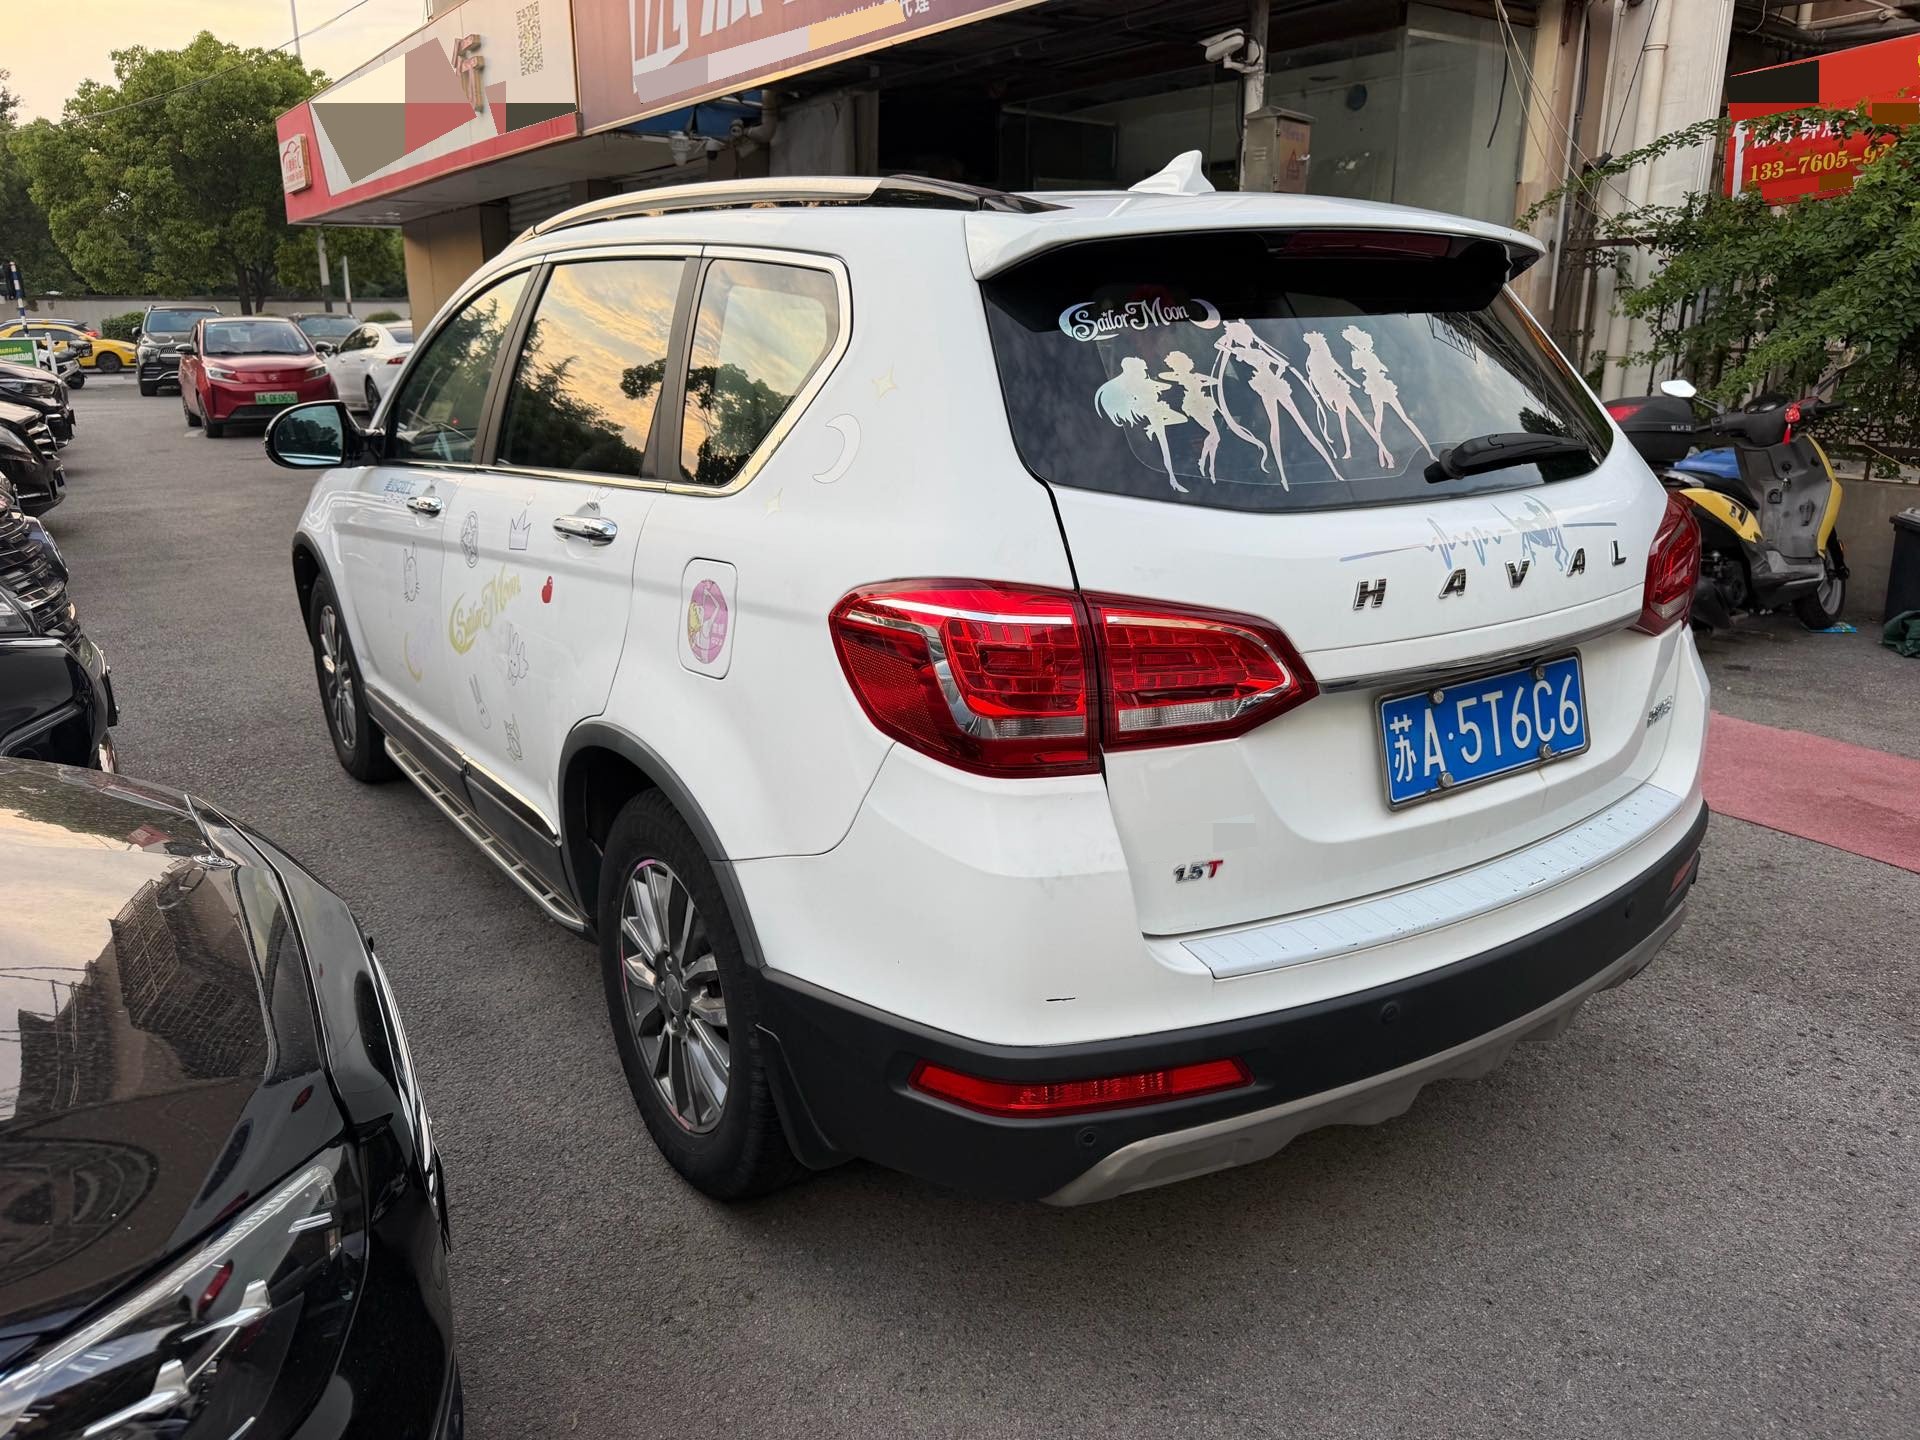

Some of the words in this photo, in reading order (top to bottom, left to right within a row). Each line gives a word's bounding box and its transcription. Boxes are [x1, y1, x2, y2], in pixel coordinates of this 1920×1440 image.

[1072, 309, 1129, 342] Sailor
[1125, 297, 1190, 331] Moon
[1353, 540, 1627, 610] HAVAL
